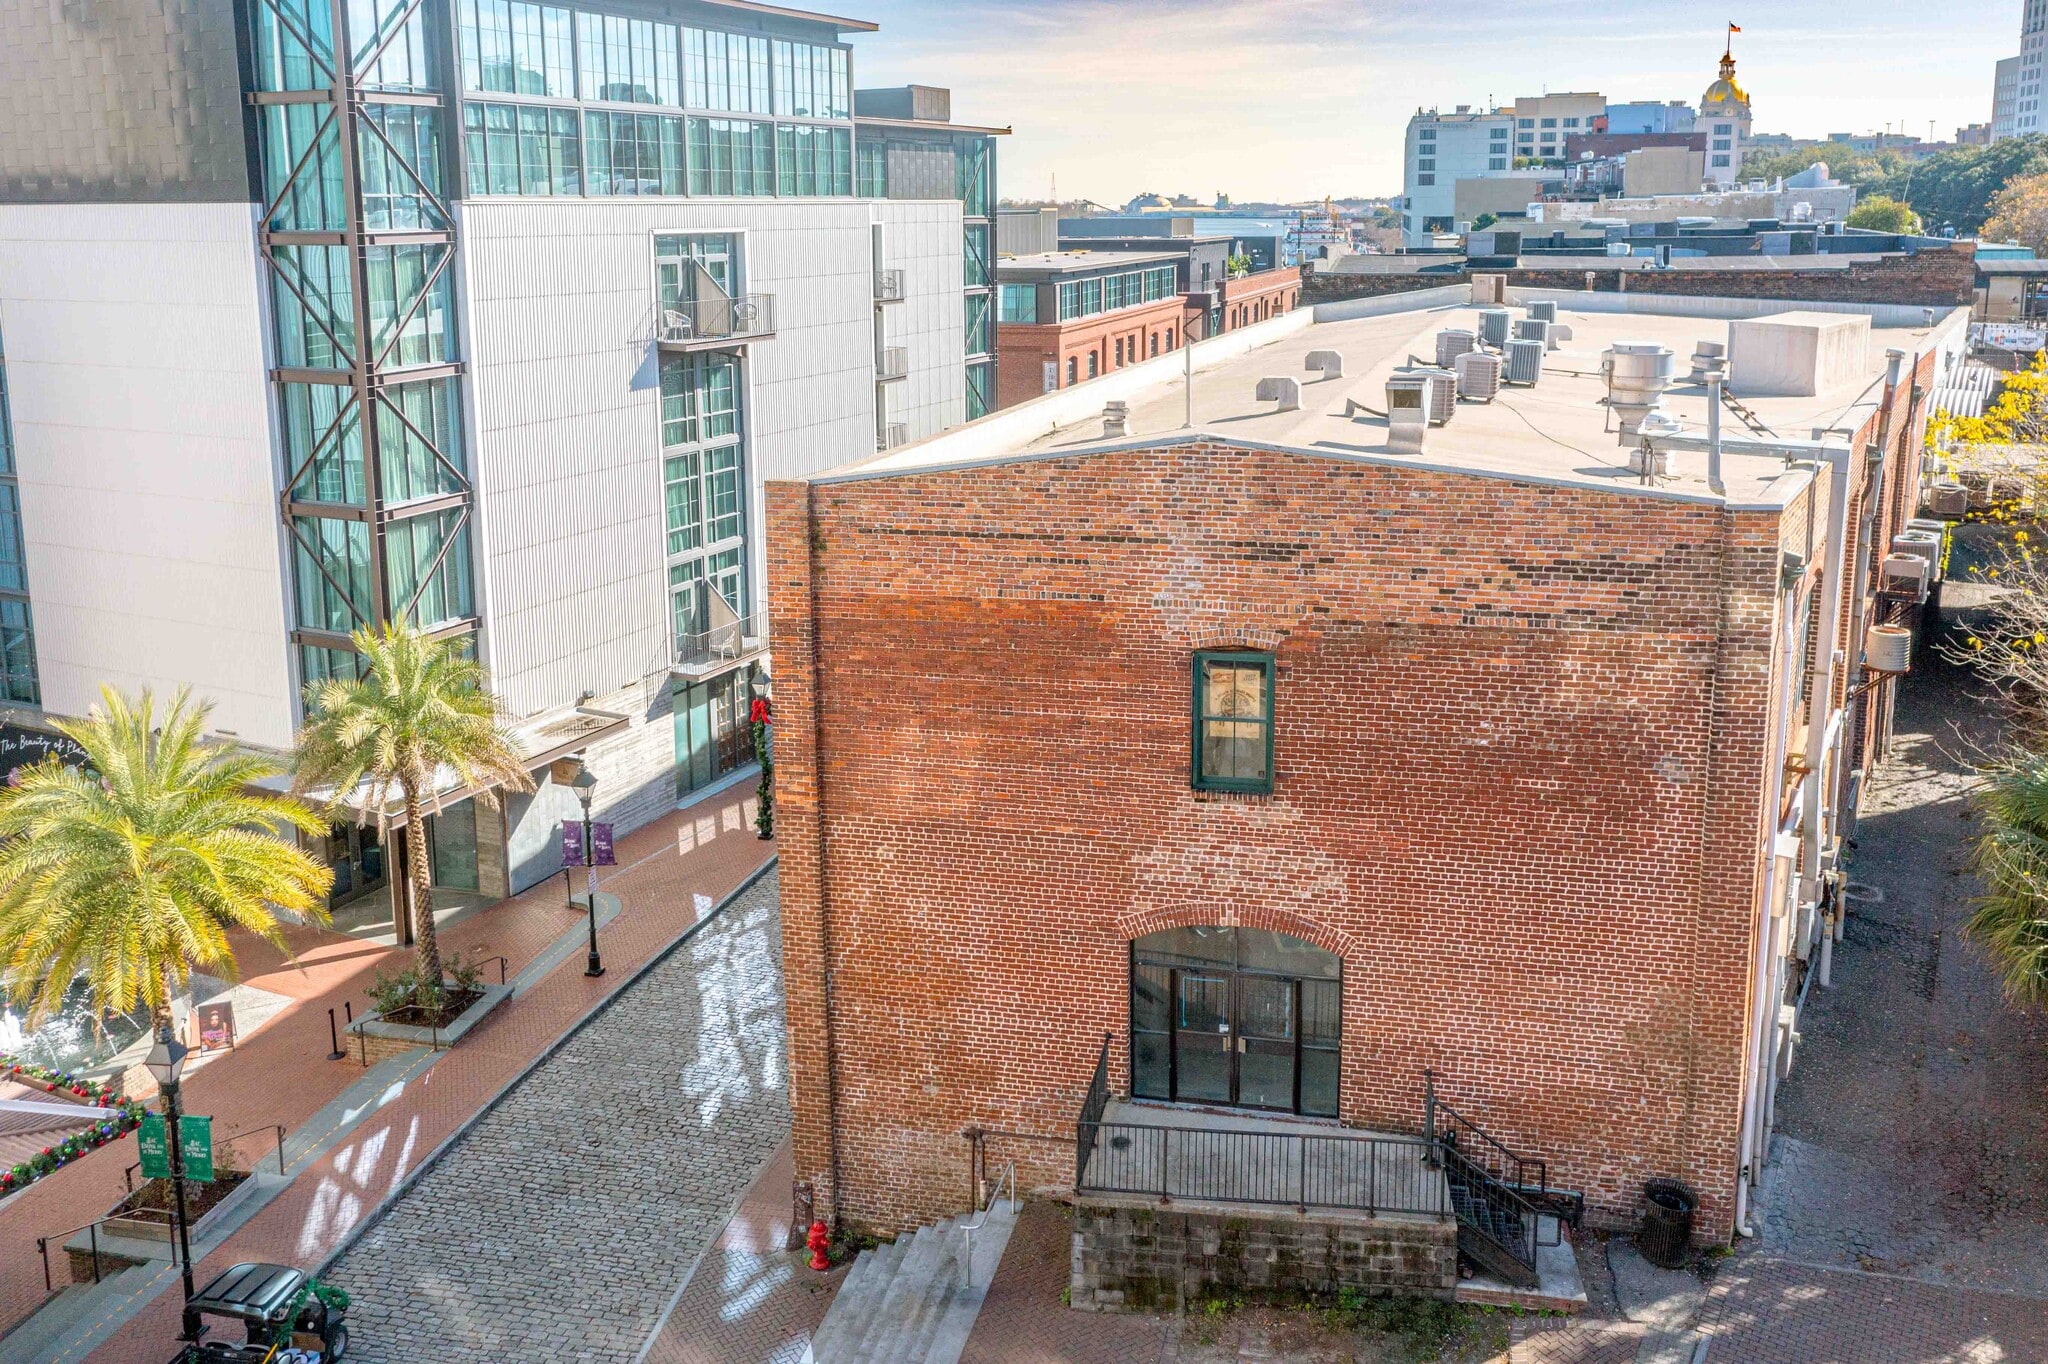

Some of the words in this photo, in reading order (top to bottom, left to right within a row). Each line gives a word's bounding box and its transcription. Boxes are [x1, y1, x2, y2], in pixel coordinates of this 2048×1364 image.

[1, 738, 17, 754] The
[20, 734, 51, 753] Beauty
[53, 738, 65, 752] of
